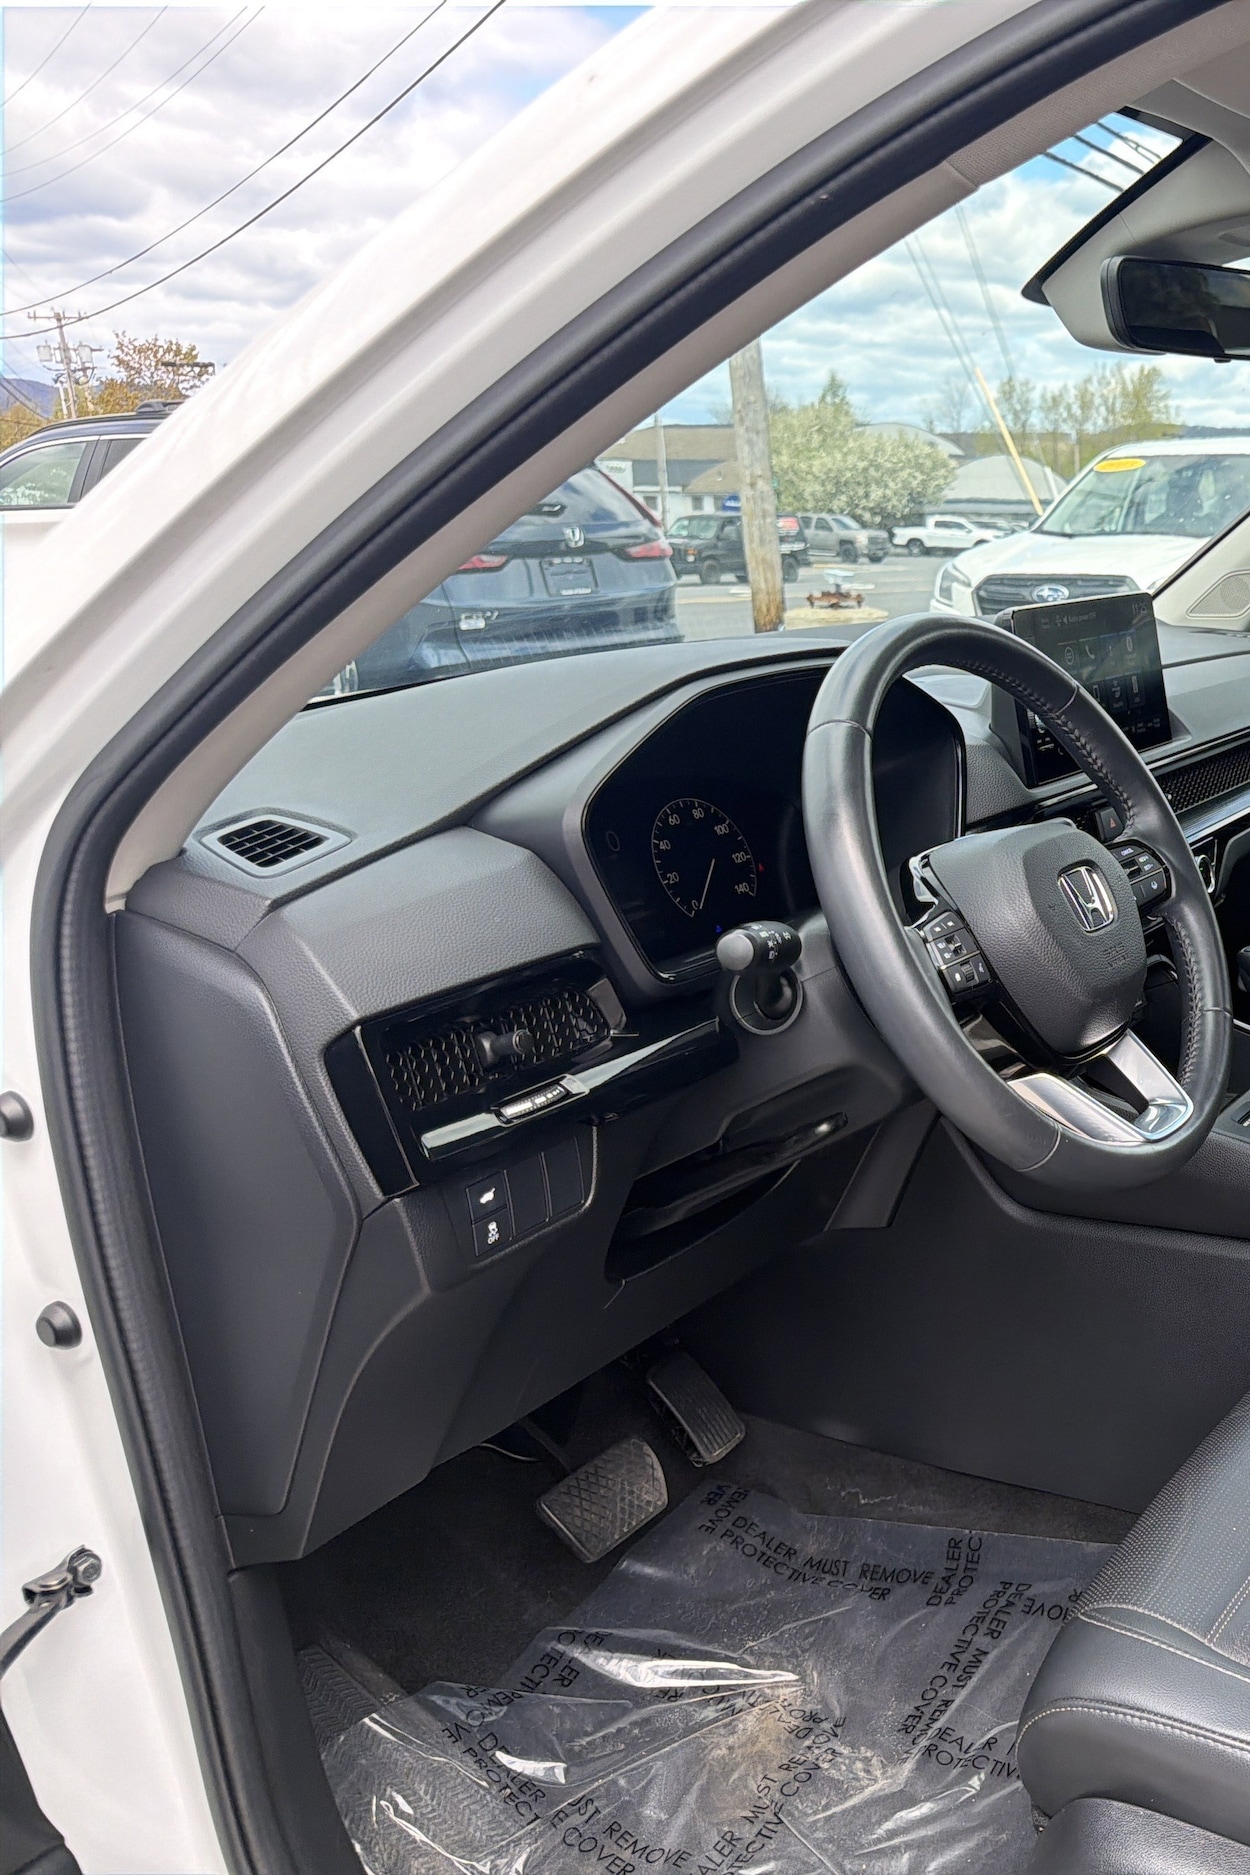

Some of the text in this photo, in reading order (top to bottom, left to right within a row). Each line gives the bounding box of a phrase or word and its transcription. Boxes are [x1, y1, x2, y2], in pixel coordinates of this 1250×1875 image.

[668, 813, 681, 826] 60
[692, 807, 705, 820] 80
[714, 823, 730, 836] 100
[659, 839, 671, 851] 40
[731, 851, 747, 864] 120
[666, 871, 680, 884] 20
[734, 882, 750, 895] 140
[699, 1486, 750, 1535] EMOVE
[720, 1528, 891, 1601] PROTECTIVE COVER
[732, 1515, 936, 1586] DEALER MUST REMOVE
[926, 1536, 964, 1607] DEALER
[944, 1530, 983, 1606] PROTEC
[983, 1582, 1032, 1640] DEALER
[1020, 1597, 1069, 1622] OVE
[898, 1580, 1013, 1735] PROTECTIVE COVER
[952, 1647, 990, 1690] MUST
[914, 1743, 1020, 1779] PROTECTIV
[567, 1795, 601, 1824] UST
[602, 1821, 692, 1869] REMOVE
[698, 1830, 743, 1875] ALER
[741, 1773, 778, 1815] MUST
[562, 1826, 636, 1875] COVER
